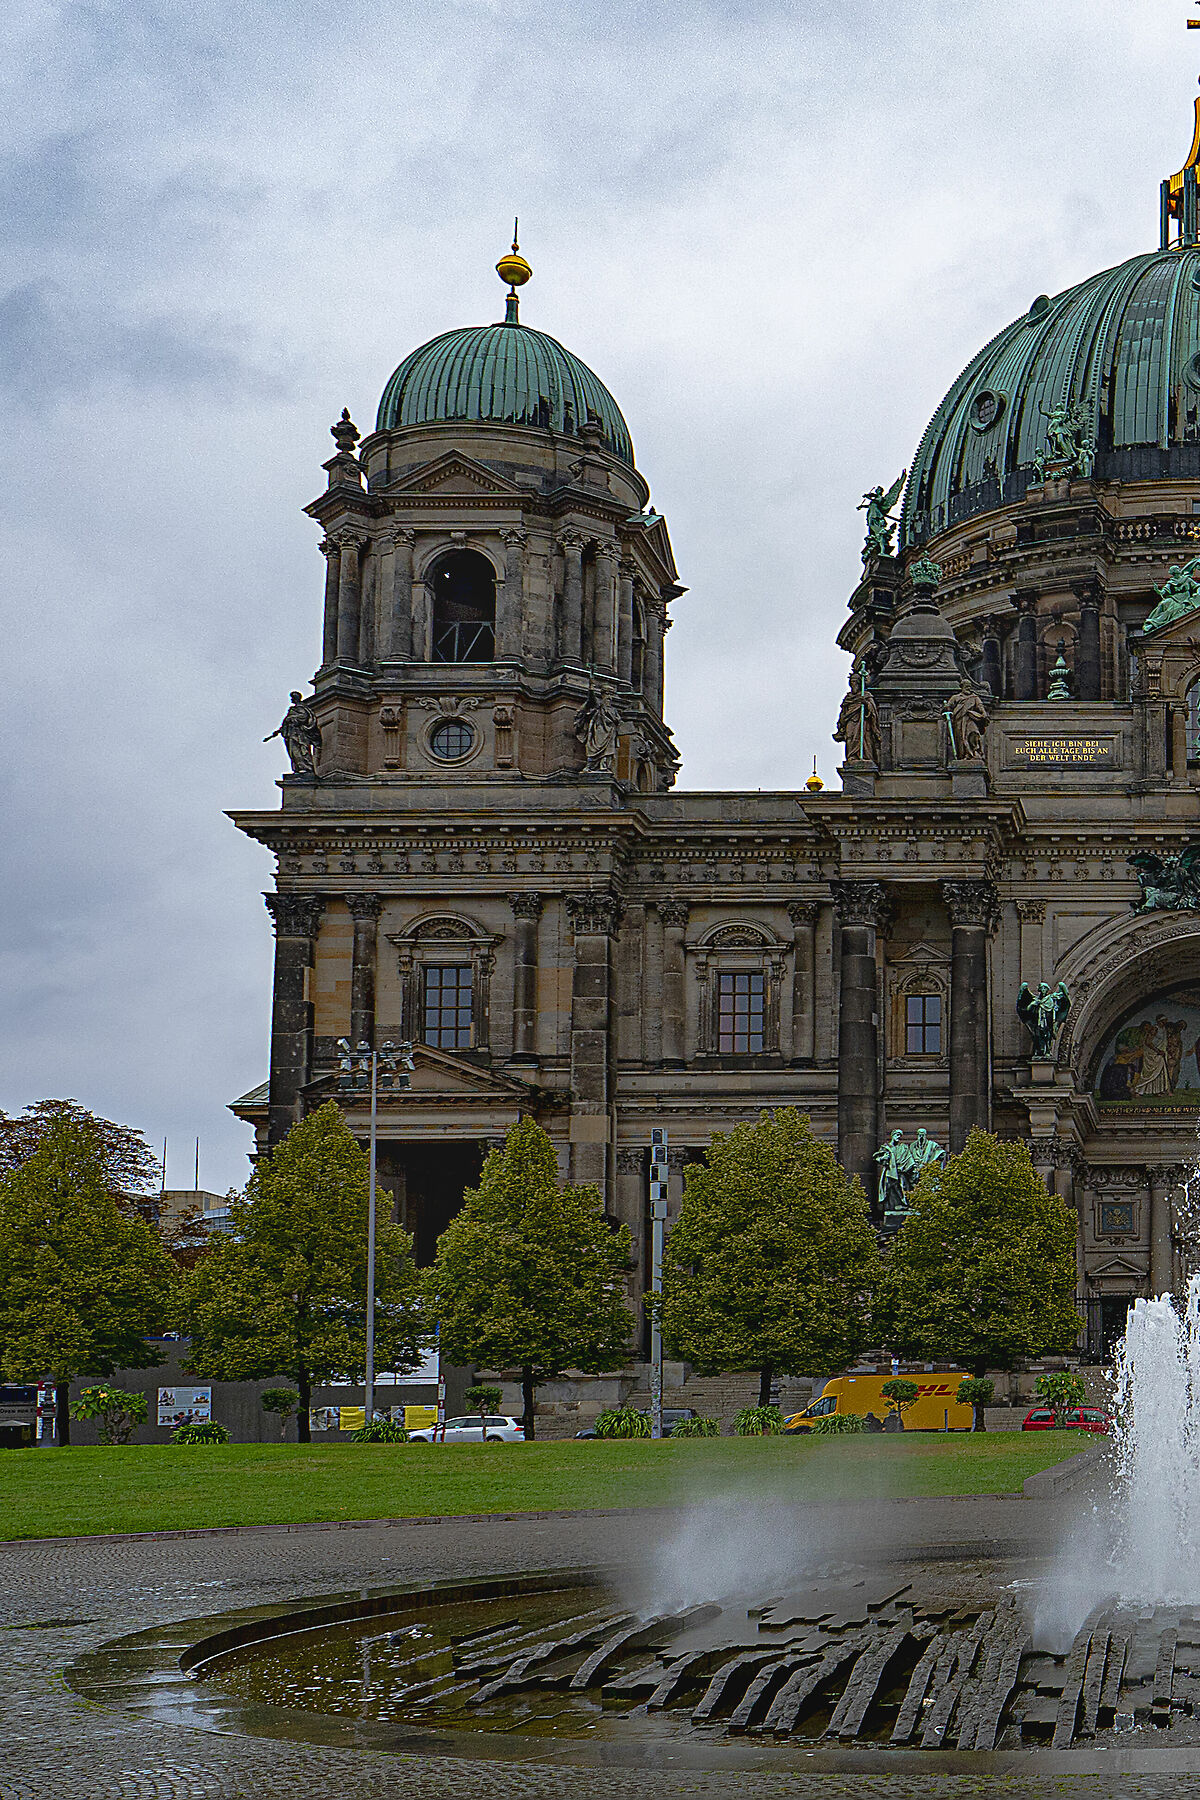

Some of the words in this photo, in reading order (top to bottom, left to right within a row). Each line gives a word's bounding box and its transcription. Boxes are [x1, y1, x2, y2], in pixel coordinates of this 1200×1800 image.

[1051, 740, 1066, 748] ICH
[1068, 740, 1083, 748] BIN
[1085, 740, 1099, 748] BEI
[1015, 747, 1036, 755] EUCH
[1038, 747, 1058, 755] ALLE
[1060, 747, 1080, 755] TAGE
[1082, 747, 1095, 755] BIS
[1097, 747, 1109, 755] AN
[1030, 754, 1046, 762] DER
[1048, 754, 1070, 762] WELT
[1072, 754, 1097, 762] ENDE.
